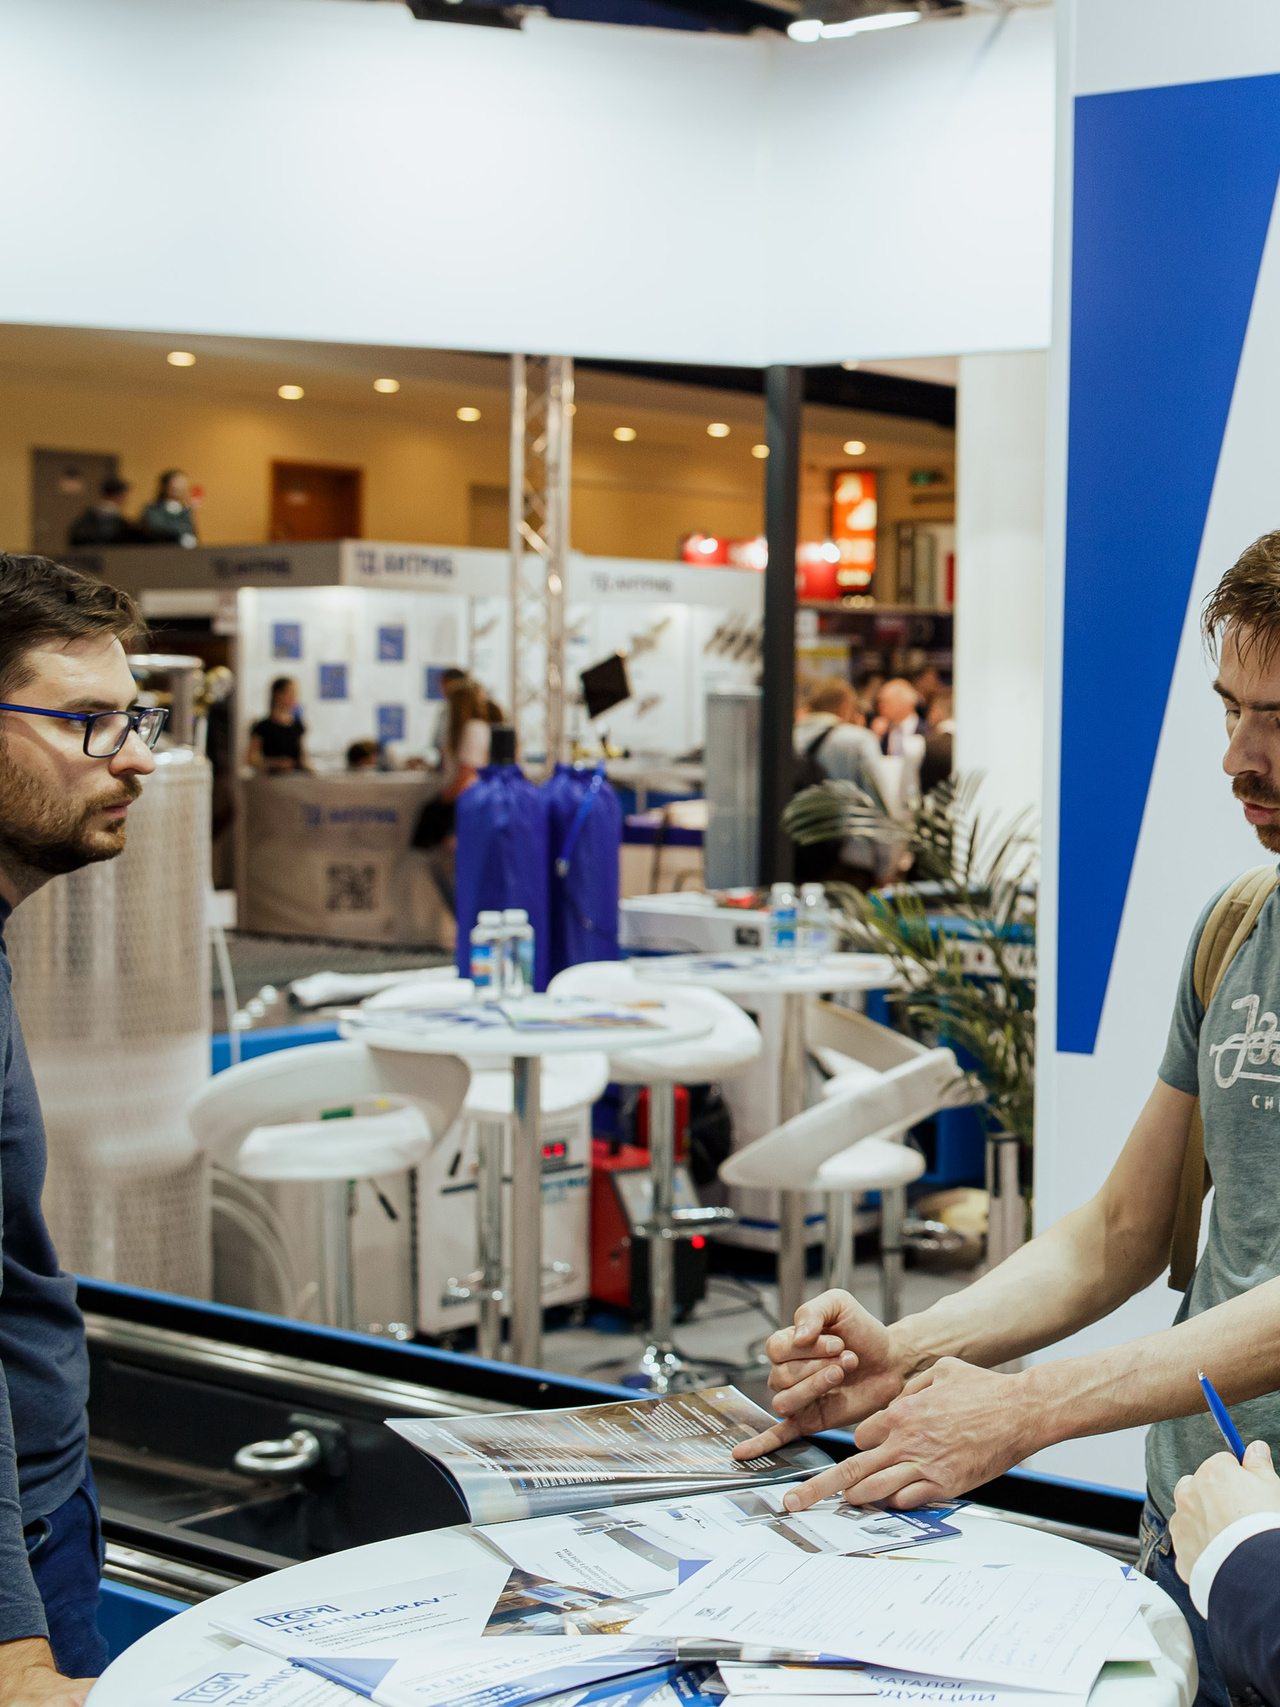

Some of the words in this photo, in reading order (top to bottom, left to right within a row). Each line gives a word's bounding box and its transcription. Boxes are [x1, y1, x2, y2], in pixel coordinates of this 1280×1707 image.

[262, 1605, 336, 1625] TGM
[182, 1674, 241, 1702] TGM
[870, 1674, 969, 1689] КАТАЛОГ
